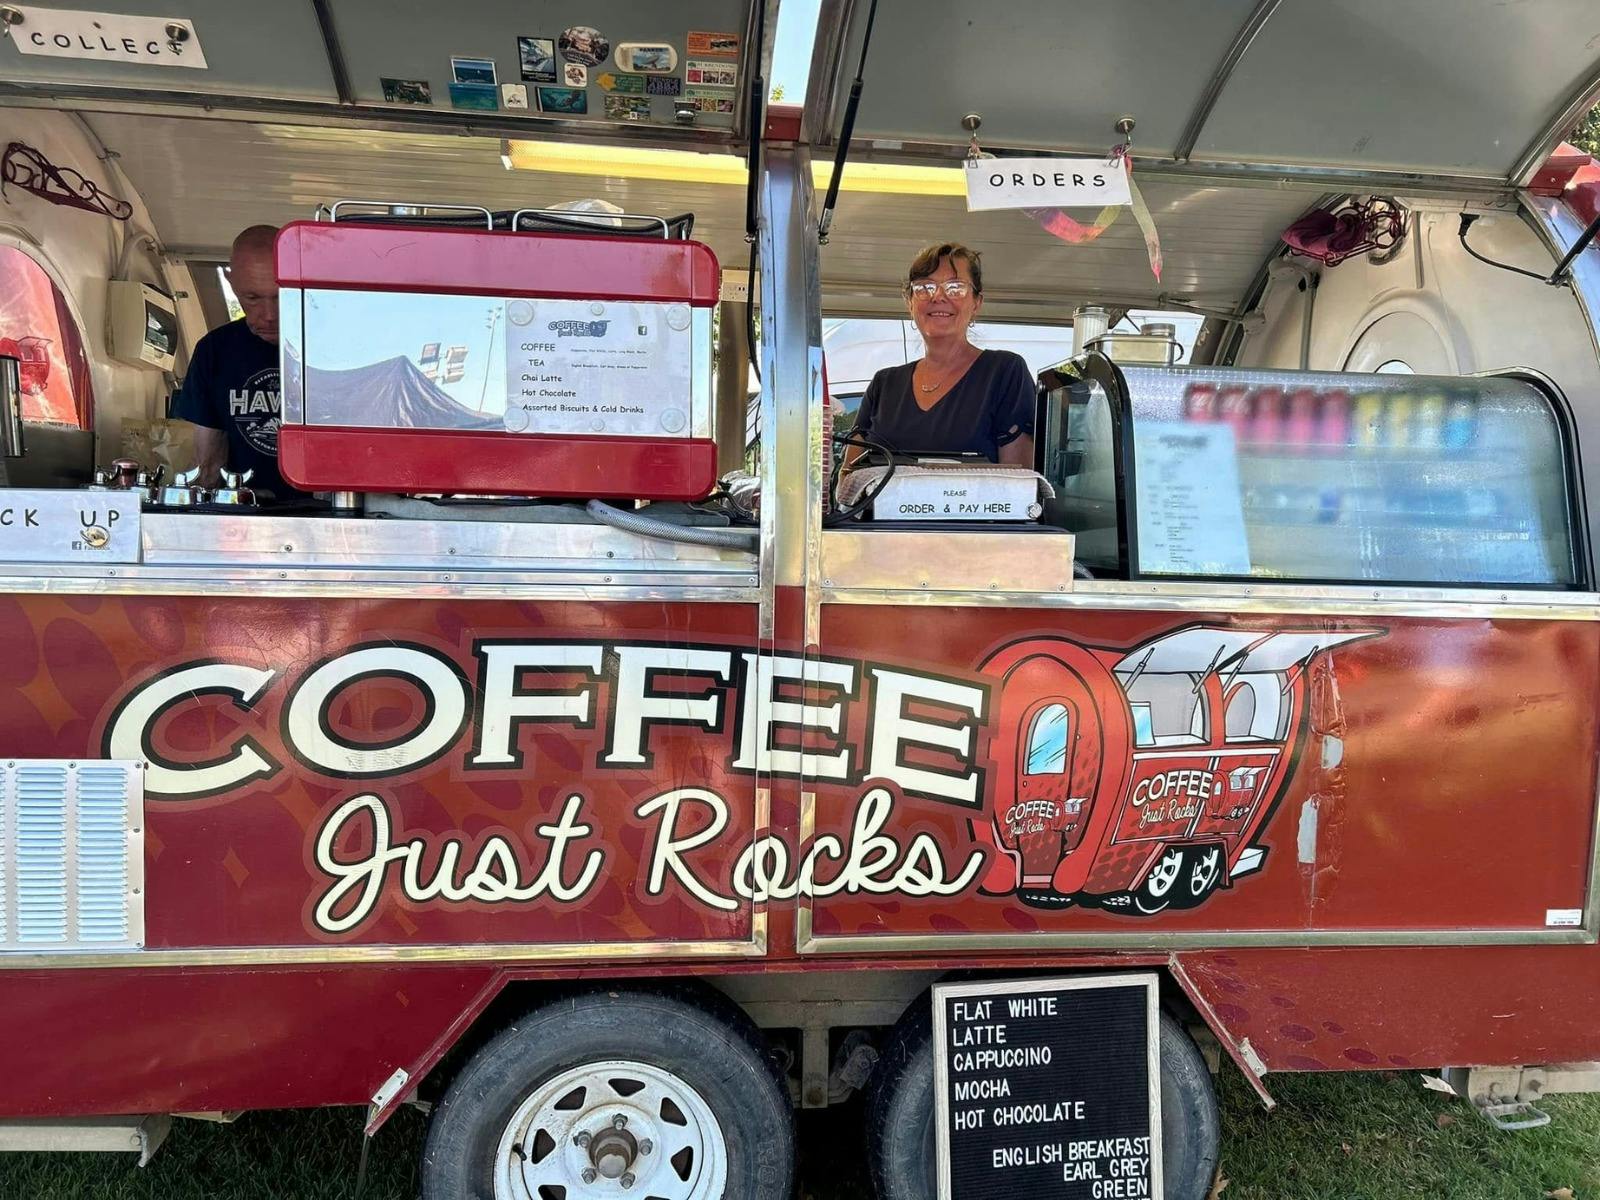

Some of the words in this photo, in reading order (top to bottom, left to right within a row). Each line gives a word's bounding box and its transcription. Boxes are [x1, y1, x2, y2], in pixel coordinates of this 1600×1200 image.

[989, 173, 1106, 187] ORDERS
[548, 320, 591, 331] COFFEE
[520, 343, 556, 352] COFFEE
[528, 359, 545, 367] TEA
[521, 374, 538, 382] Chai
[541, 374, 562, 382] Latte
[521, 389, 536, 397] Hot
[539, 389, 577, 397] Chocolate
[522, 404, 557, 412] Assorted
[560, 404, 590, 413] Biscuits
[592, 405, 598, 413] &
[600, 405, 617, 413] Cold
[620, 406, 644, 414] Drinks
[80, 510, 120, 527] UP
[899, 503, 935, 514] ORDER
[943, 504, 950, 513] &
[959, 503, 979, 513] PAY
[983, 503, 1011, 513] HERE
[103, 640, 989, 806] COFFEE
[1132, 769, 1214, 807] COFFEE
[1005, 800, 1055, 824] COFFEE
[1139, 801, 1166, 829] Just
[1167, 797, 1198, 822] Rocks
[313, 793, 602, 933] Just
[635, 787, 985, 911] Rocks
[953, 1000, 993, 1022] FLAT
[1008, 997, 1058, 1018] WHITE
[953, 1025, 1007, 1047] LATTE
[953, 1046, 1051, 1072] CAPPUCCINO
[955, 1078, 1011, 1101] MOCHA
[955, 1108, 986, 1130] HOT
[993, 1101, 1085, 1126] CHOCOLATE
[993, 1143, 1062, 1168] ENGLISH
[1068, 1136, 1150, 1161] BREAKFAST
[1063, 1161, 1102, 1181] EARL
[1109, 1157, 1149, 1177] GREY
[1092, 1177, 1148, 1199] GREEN
